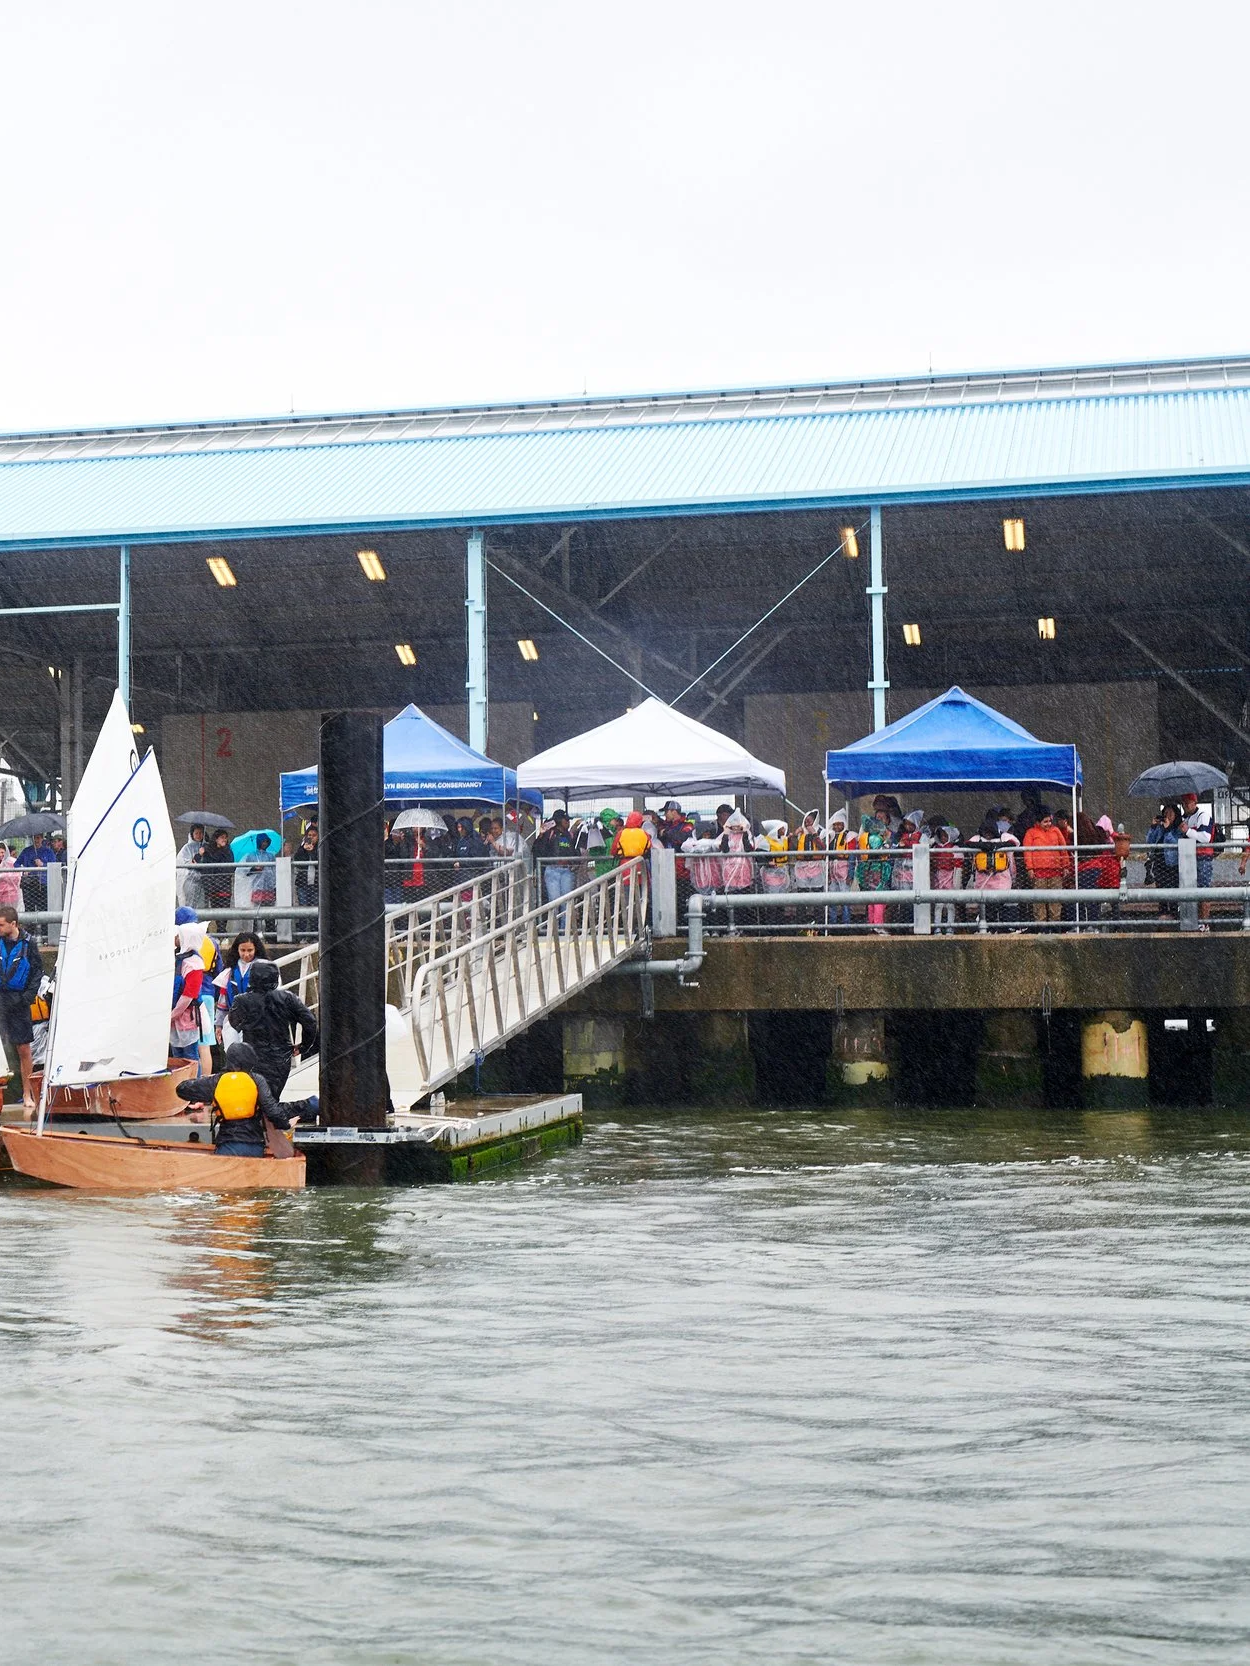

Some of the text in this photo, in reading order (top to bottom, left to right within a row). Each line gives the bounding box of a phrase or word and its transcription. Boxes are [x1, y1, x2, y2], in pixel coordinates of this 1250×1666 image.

[216, 727, 233, 758] 2
[384, 782, 395, 790] LYN
[420, 781, 437, 789] PARK
[437, 781, 483, 789] CONSERVANCY
